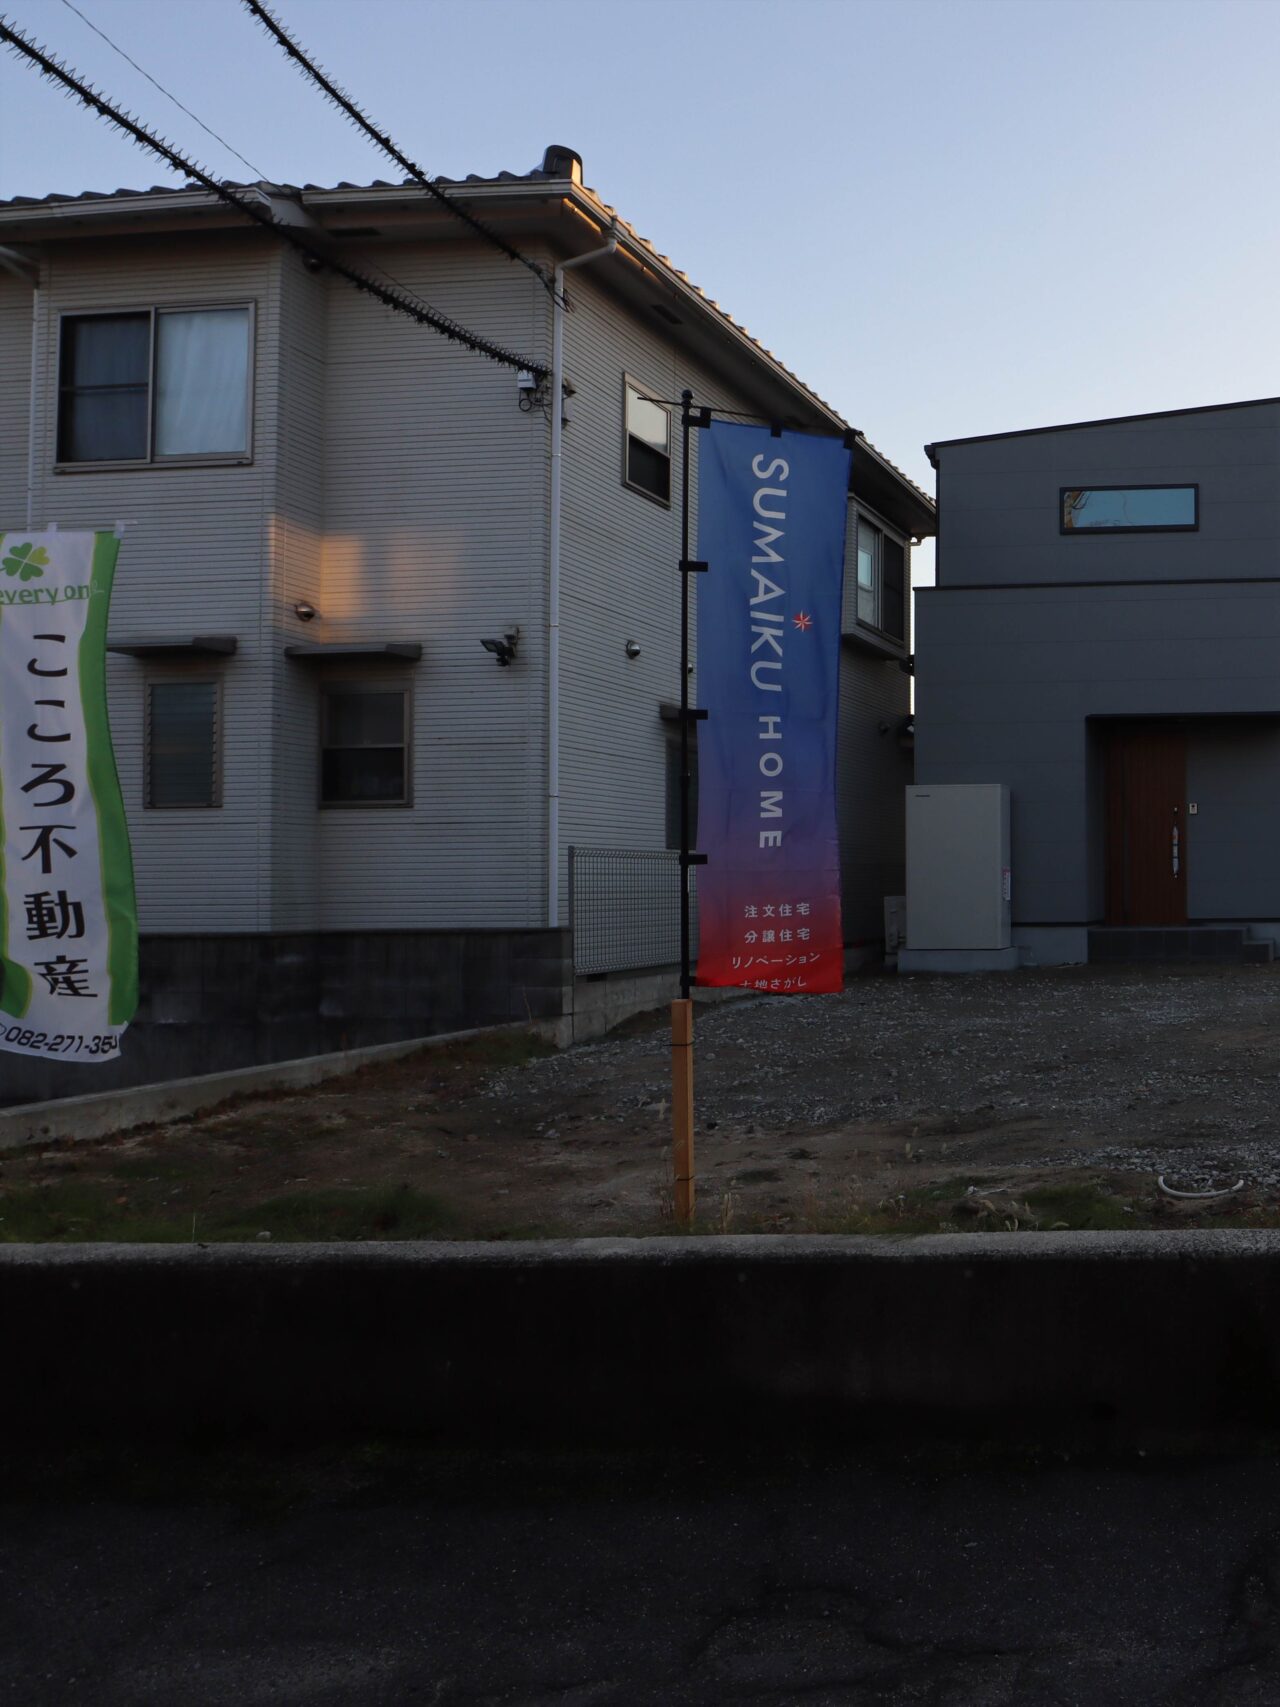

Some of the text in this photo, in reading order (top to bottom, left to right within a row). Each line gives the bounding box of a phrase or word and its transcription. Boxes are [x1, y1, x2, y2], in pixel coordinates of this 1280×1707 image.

[749, 454, 789, 849] SUMAIKU HOME
[20, 633, 98, 998] こころ不動産
[744, 902, 810, 918] 注文住宅
[744, 928, 810, 943] 分譲住宅
[732, 952, 820, 969] リノベーション
